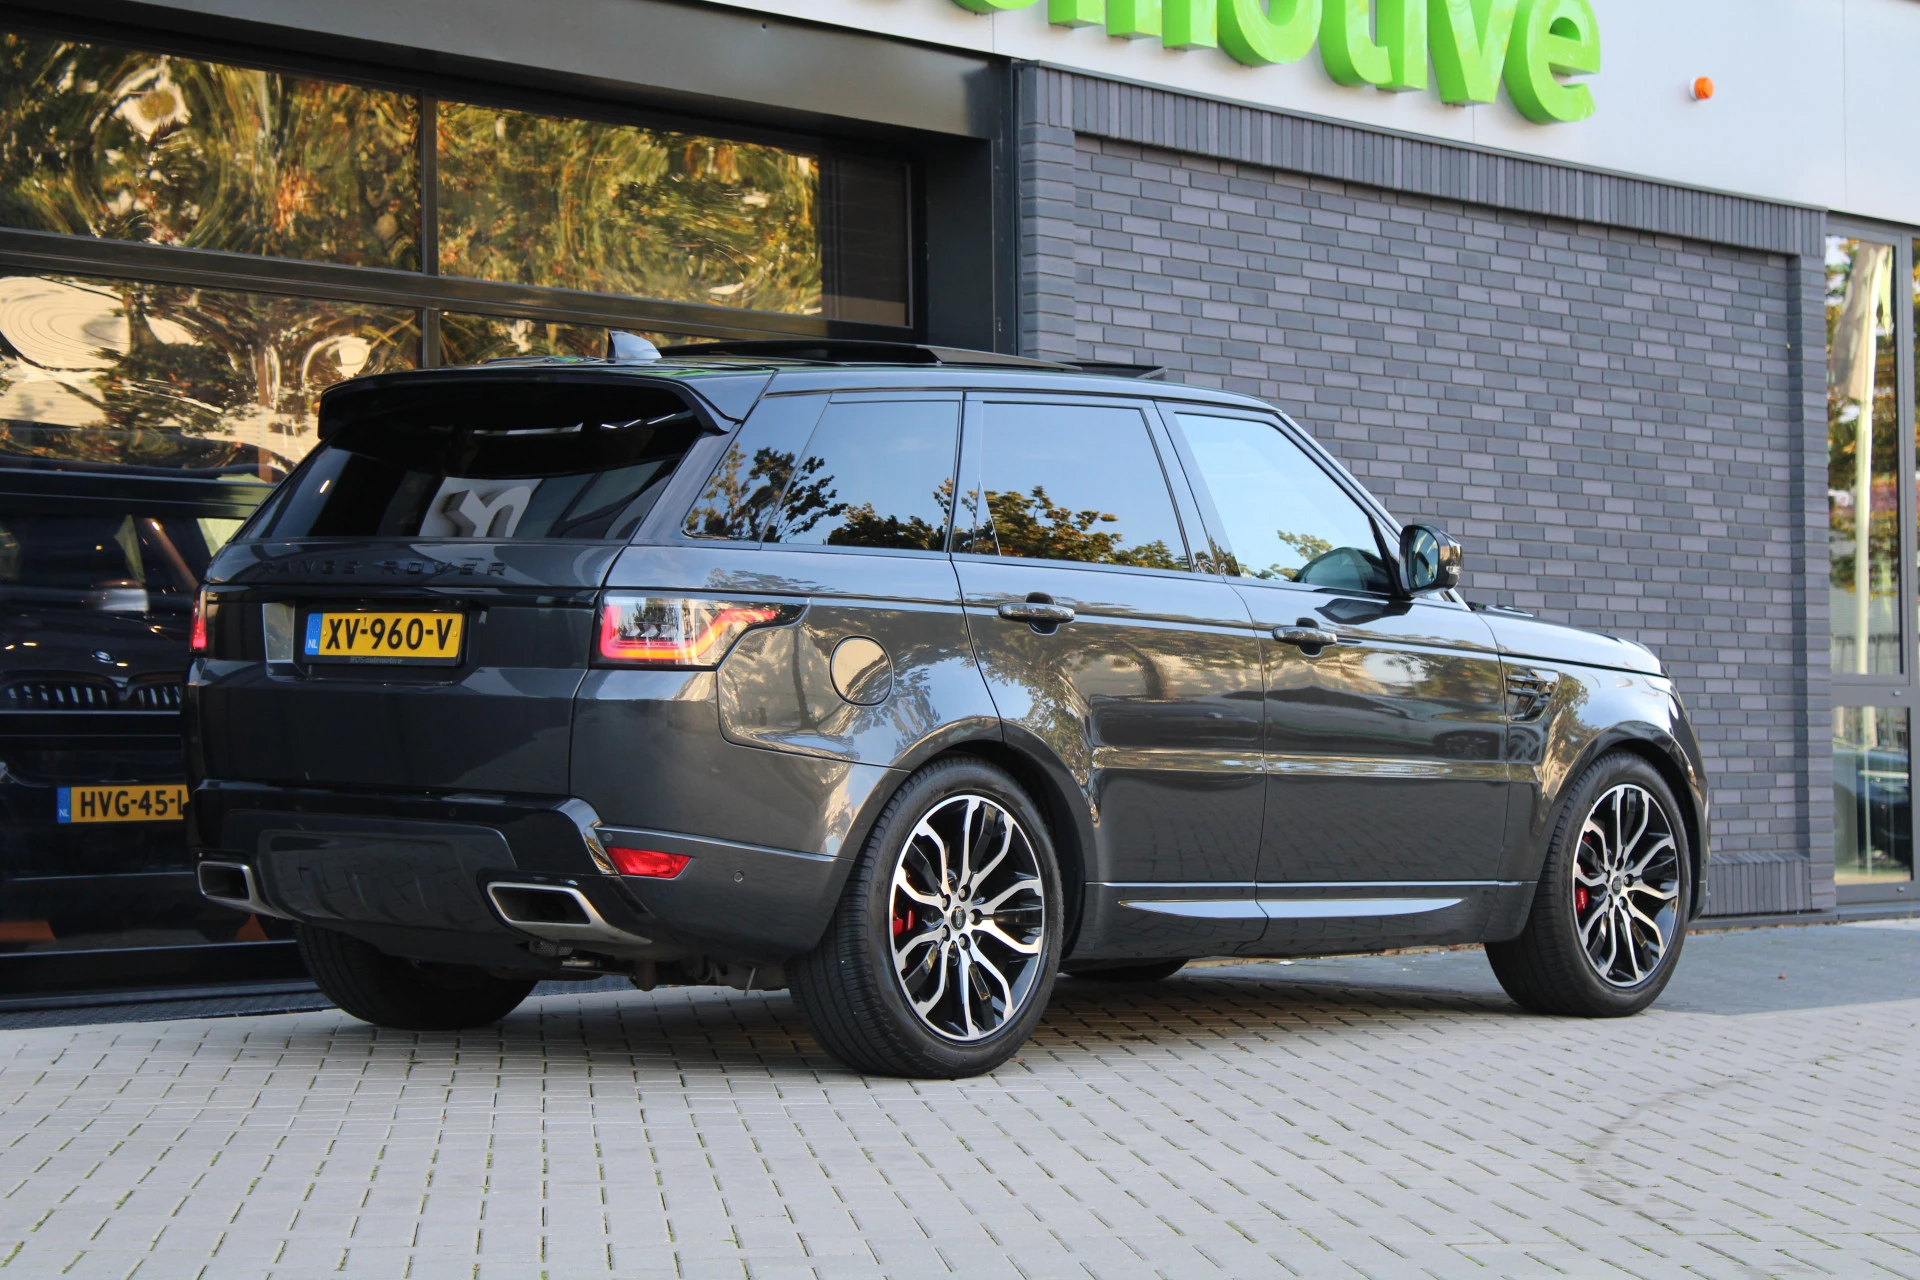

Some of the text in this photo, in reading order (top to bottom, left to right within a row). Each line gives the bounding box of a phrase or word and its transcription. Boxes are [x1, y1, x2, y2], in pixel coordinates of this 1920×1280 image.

[260, 560, 507, 578] RANGE ROVER
[307, 617, 454, 651] NL XV-960-V
[58, 808, 70, 818] NL
